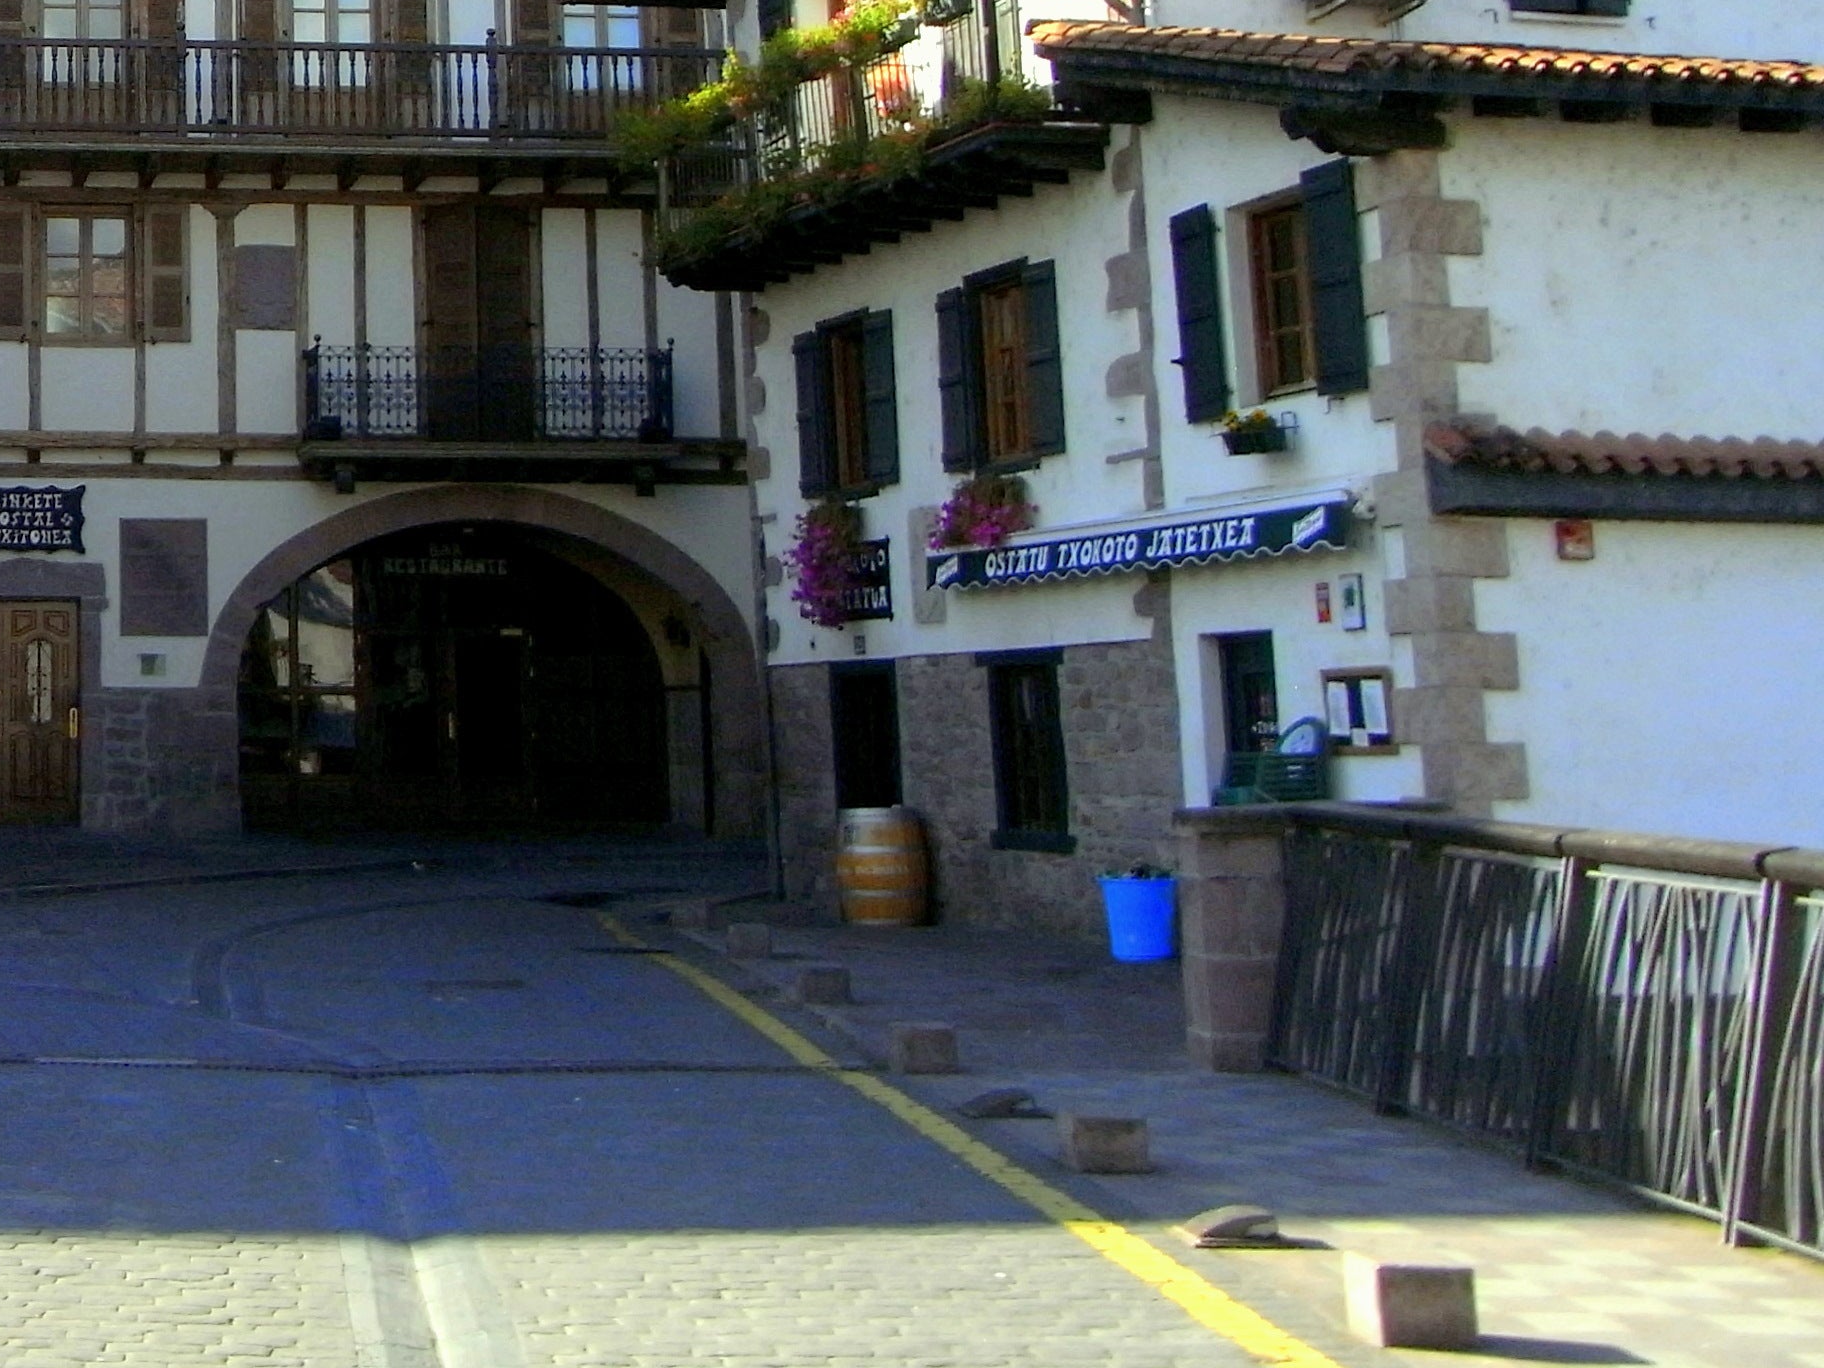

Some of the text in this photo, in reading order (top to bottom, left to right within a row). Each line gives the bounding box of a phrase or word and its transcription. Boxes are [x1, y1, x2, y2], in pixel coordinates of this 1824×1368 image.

[383, 557, 509, 576] RESTAURANTE
[984, 544, 1050, 578] OSTATU
[1056, 533, 1138, 569] TXOKOTO
[1145, 517, 1256, 559] JATETXEA
